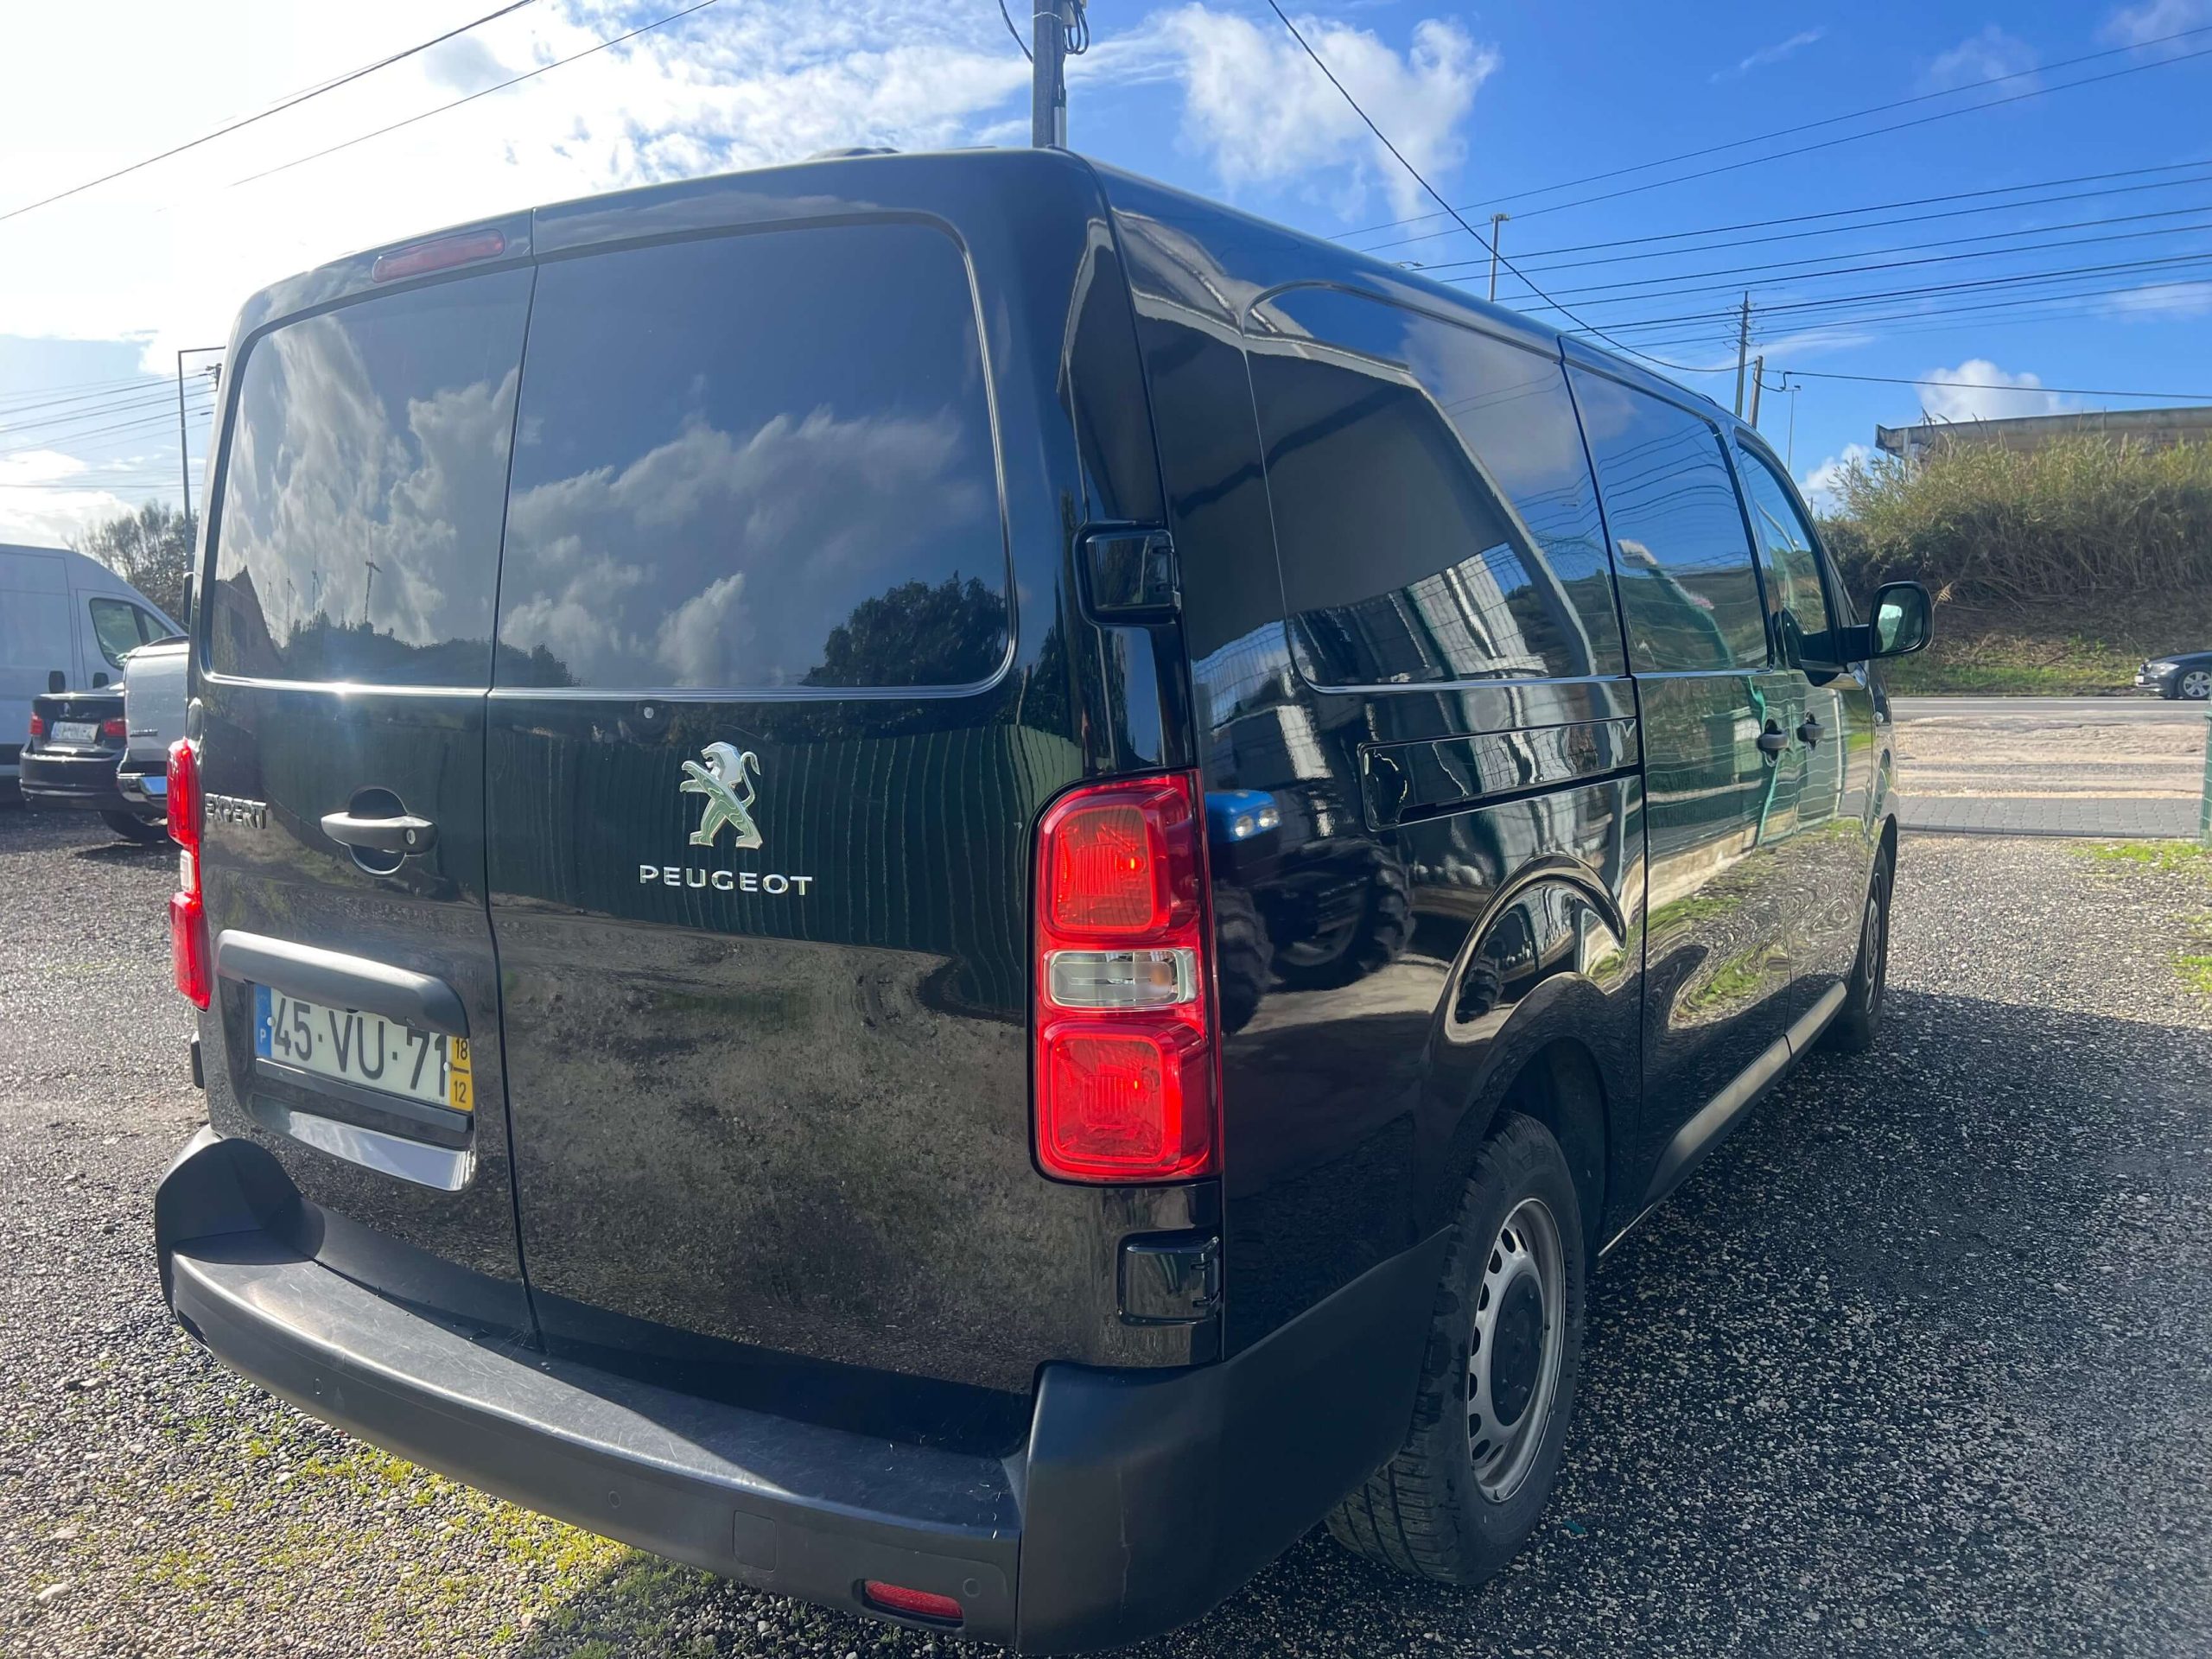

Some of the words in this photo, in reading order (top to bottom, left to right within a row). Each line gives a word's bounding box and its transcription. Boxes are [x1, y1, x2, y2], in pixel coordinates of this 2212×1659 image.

[205, 792, 267, 830] EXPERT
[639, 864, 813, 896] PEUGEOT
[259, 1027, 267, 1044] P
[455, 1038, 468, 1061] 18
[454, 1080, 467, 1104] 12
